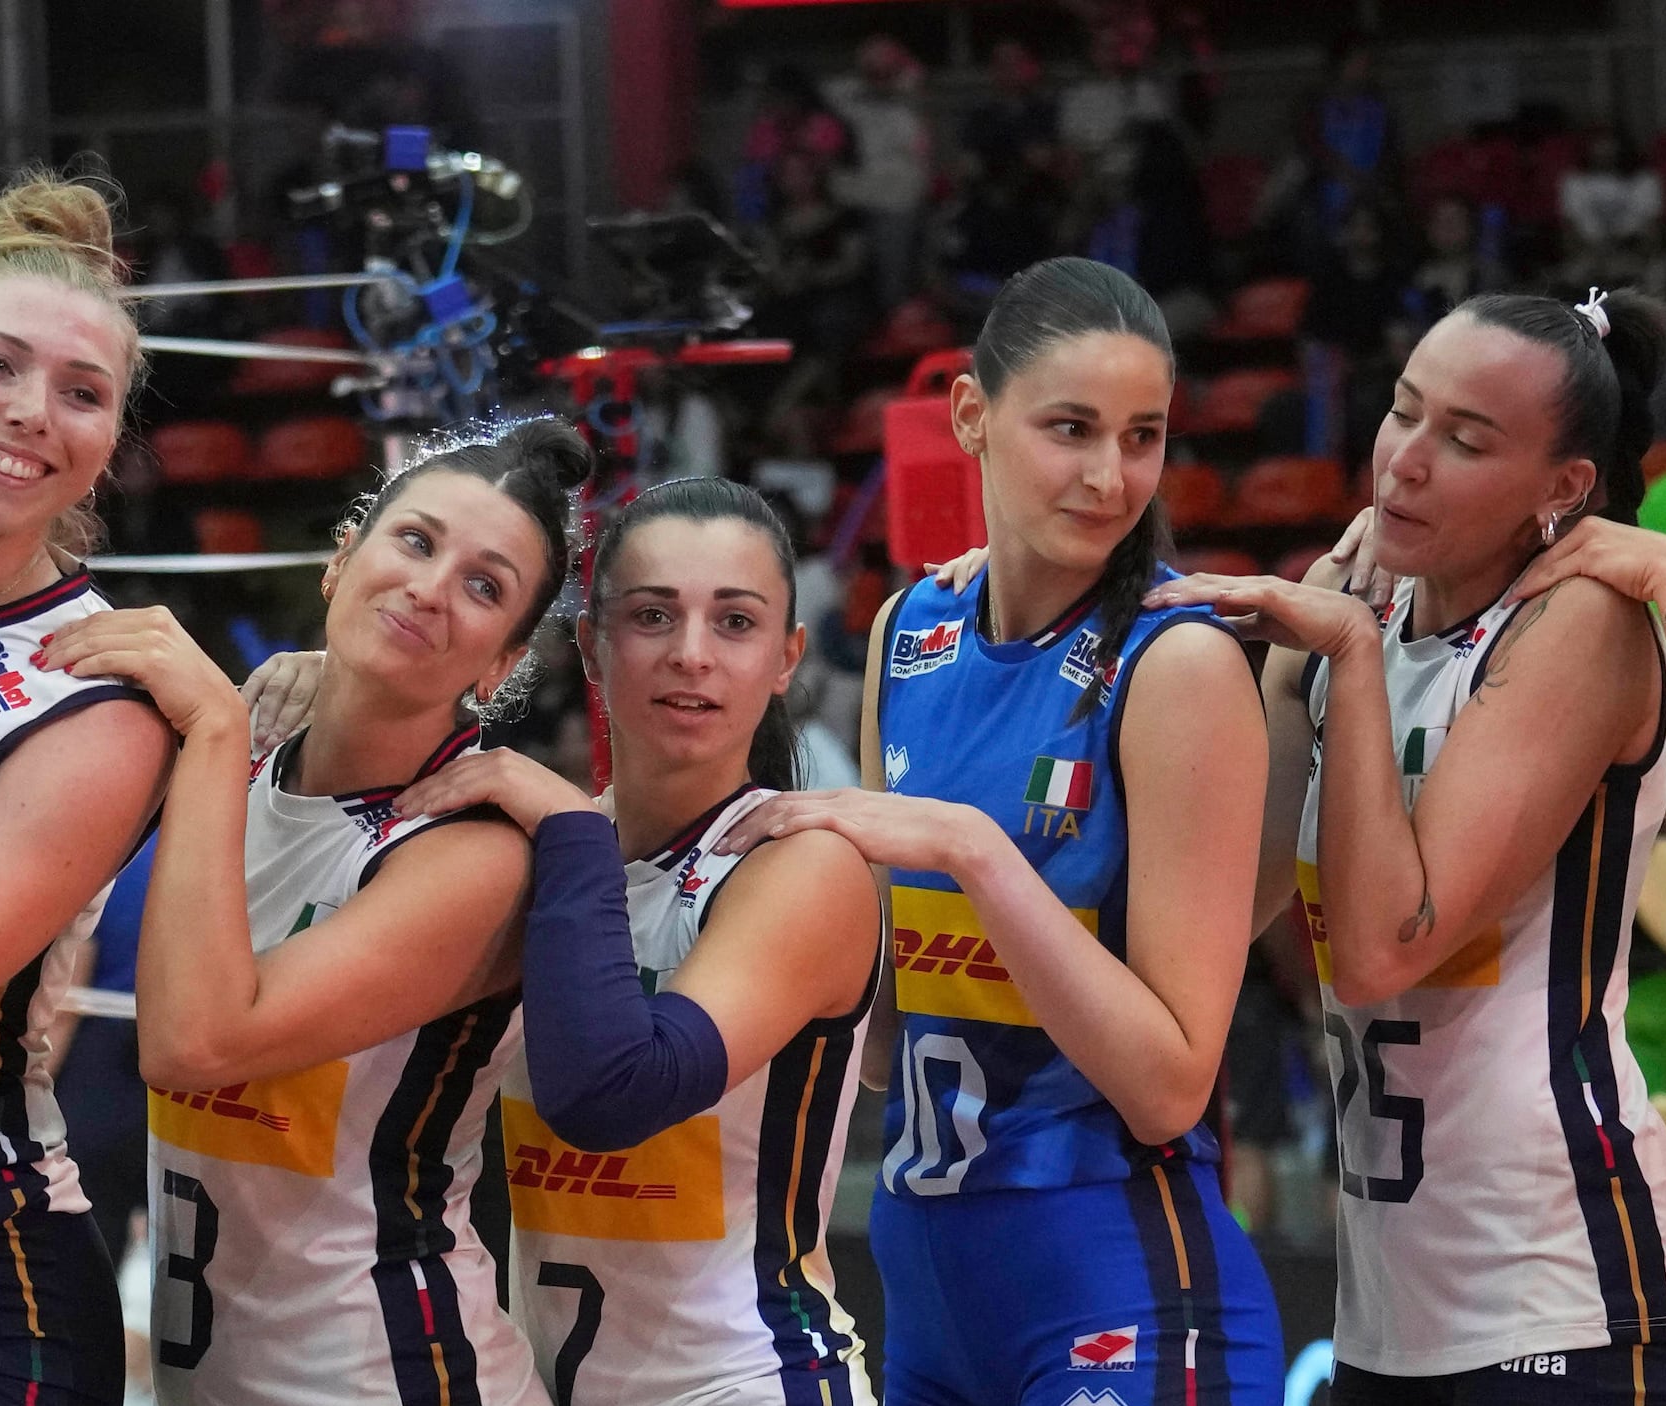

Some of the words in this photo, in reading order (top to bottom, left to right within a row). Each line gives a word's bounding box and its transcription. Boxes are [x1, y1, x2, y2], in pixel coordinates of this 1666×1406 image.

[1023, 806, 1081, 839] ITA
[1325, 1010, 1425, 1205] 25
[509, 1143, 640, 1198] DHL
